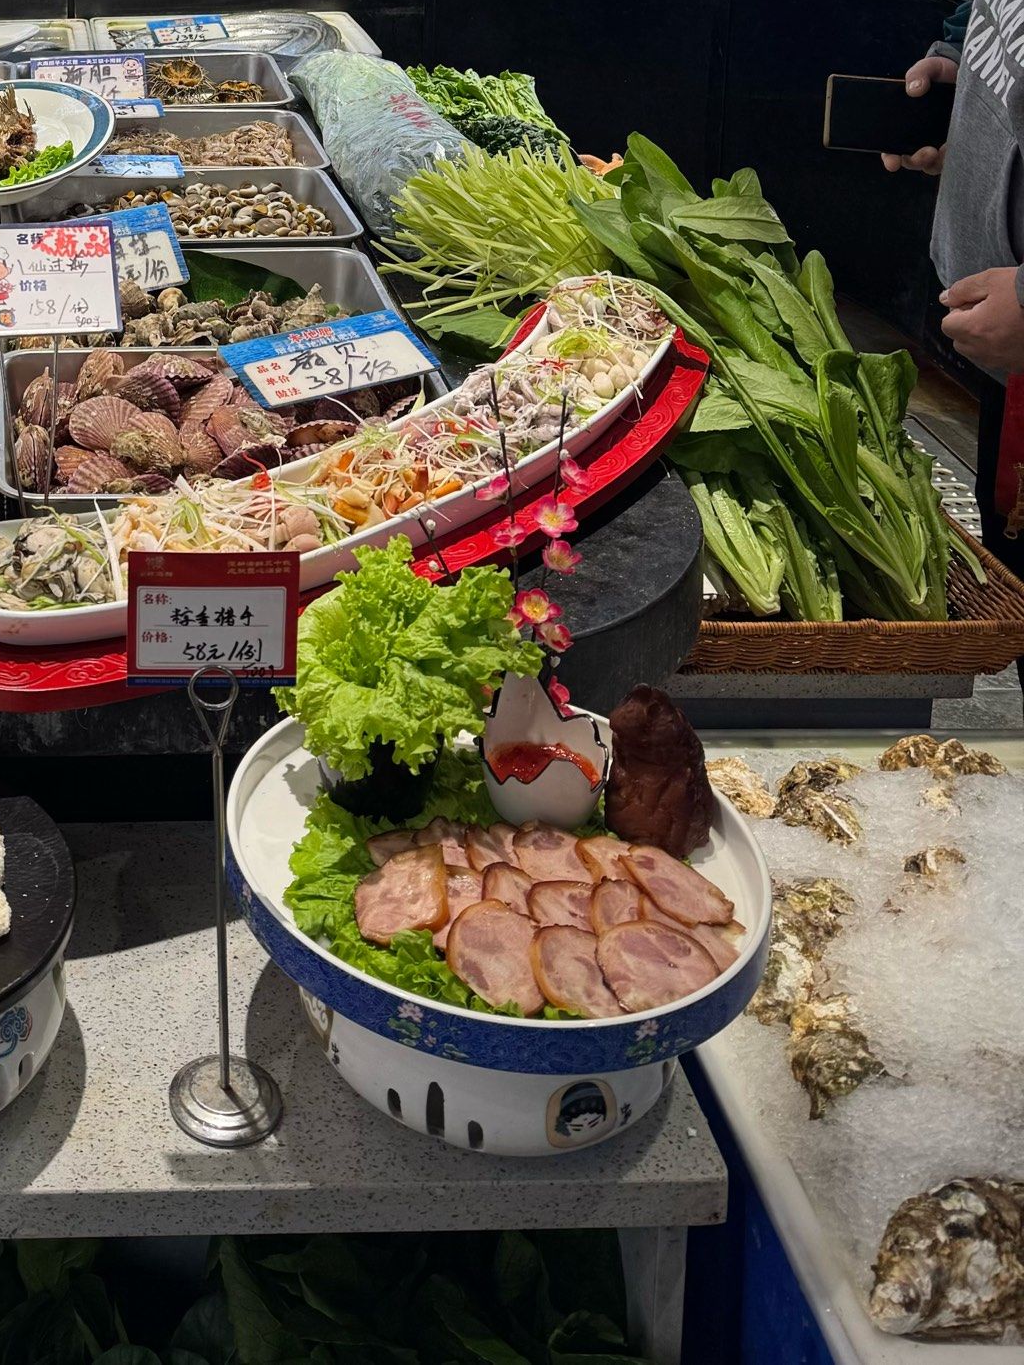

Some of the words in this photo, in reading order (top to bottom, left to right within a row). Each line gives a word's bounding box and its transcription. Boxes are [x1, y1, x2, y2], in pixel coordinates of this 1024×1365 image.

[20, 280, 47, 291] 价格
[287, 326, 333, 344] 本地肥
[257, 360, 281, 375] 品名
[266, 373, 290, 386] 单价
[275, 384, 302, 399] 做法
